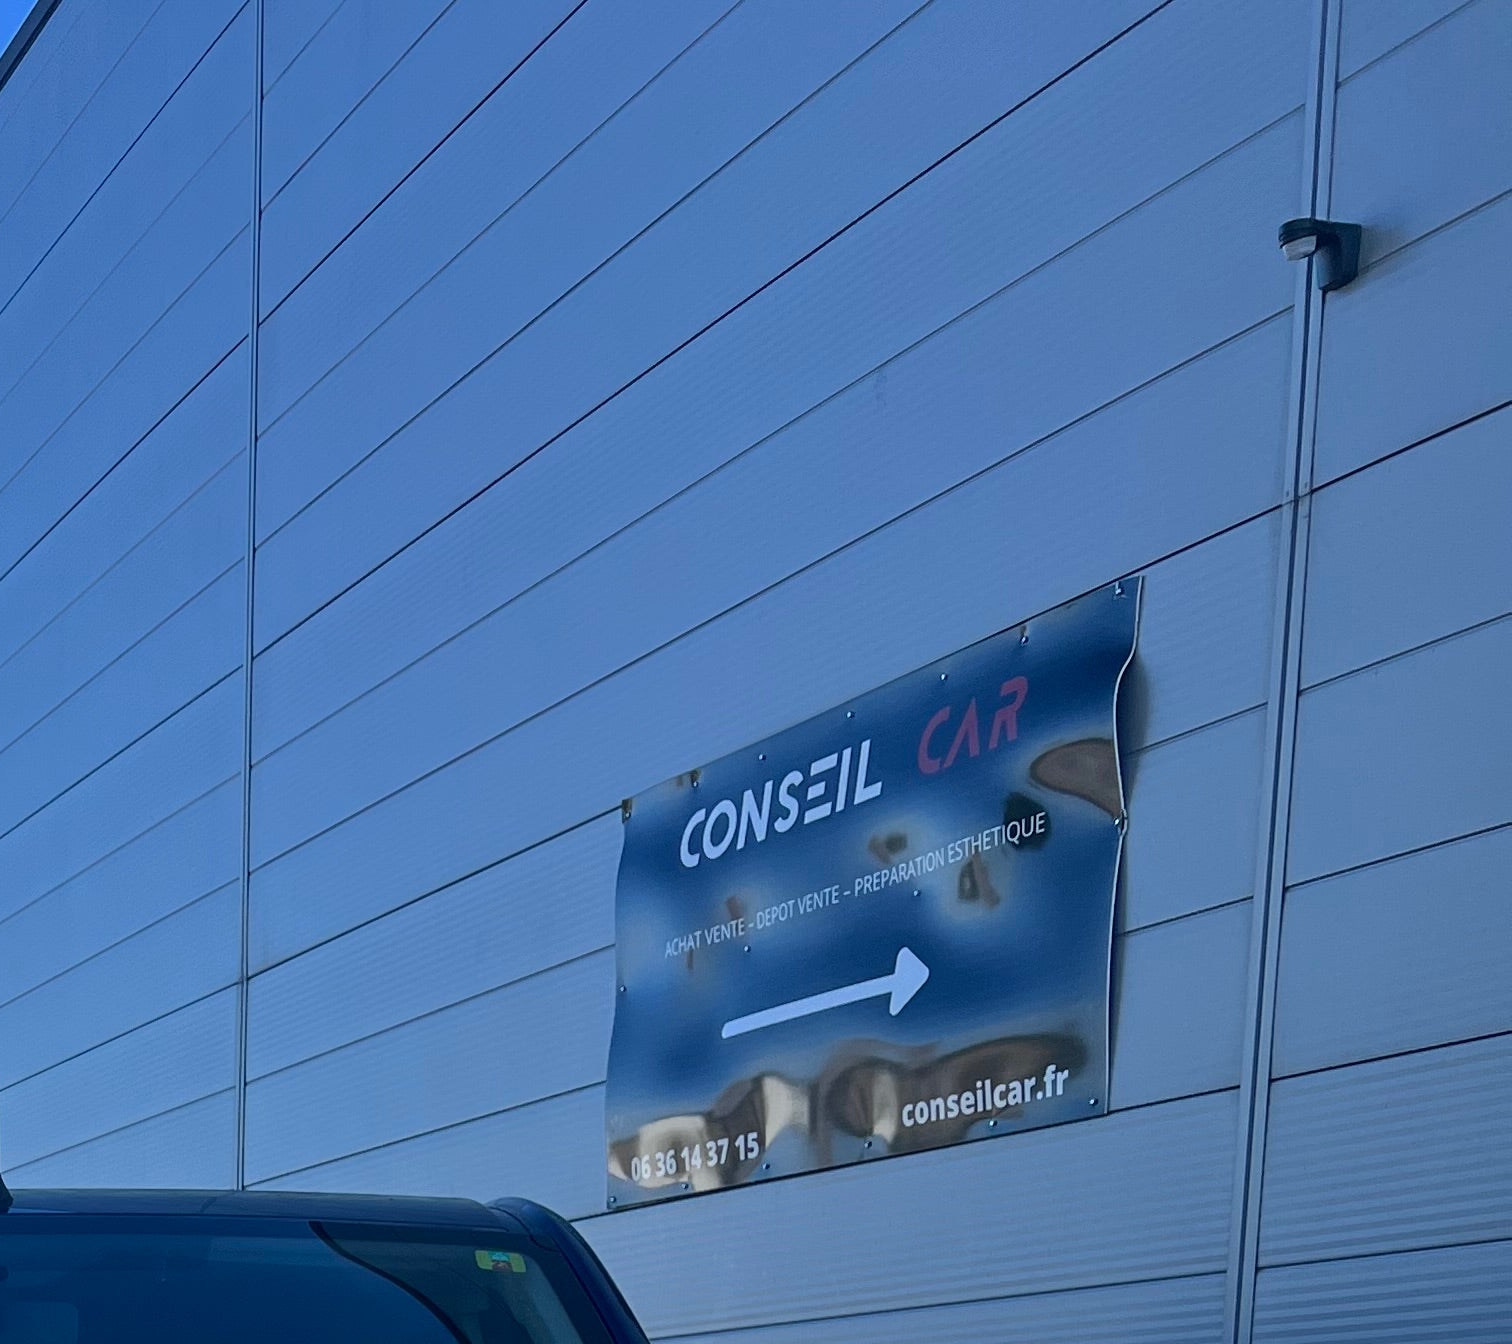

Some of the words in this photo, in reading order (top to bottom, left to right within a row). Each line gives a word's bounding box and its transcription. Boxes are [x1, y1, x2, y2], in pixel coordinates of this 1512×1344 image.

[680, 739, 883, 868] CONSEIL
[918, 676, 1028, 775] CAR
[665, 930, 702, 958] ACHAT
[704, 917, 745, 945] VENTE
[756, 900, 796, 929] DEPOT
[797, 885, 840, 914] VENTE
[854, 848, 945, 897] PREPARATION
[948, 812, 1047, 864] ESTHETIQUE
[902, 1064, 1070, 1128] conseilcar.fr
[631, 1155, 651, 1181] 06
[655, 1149, 677, 1177] 36
[681, 1144, 702, 1171] 14
[706, 1138, 729, 1167] 37
[735, 1132, 760, 1161] 15
